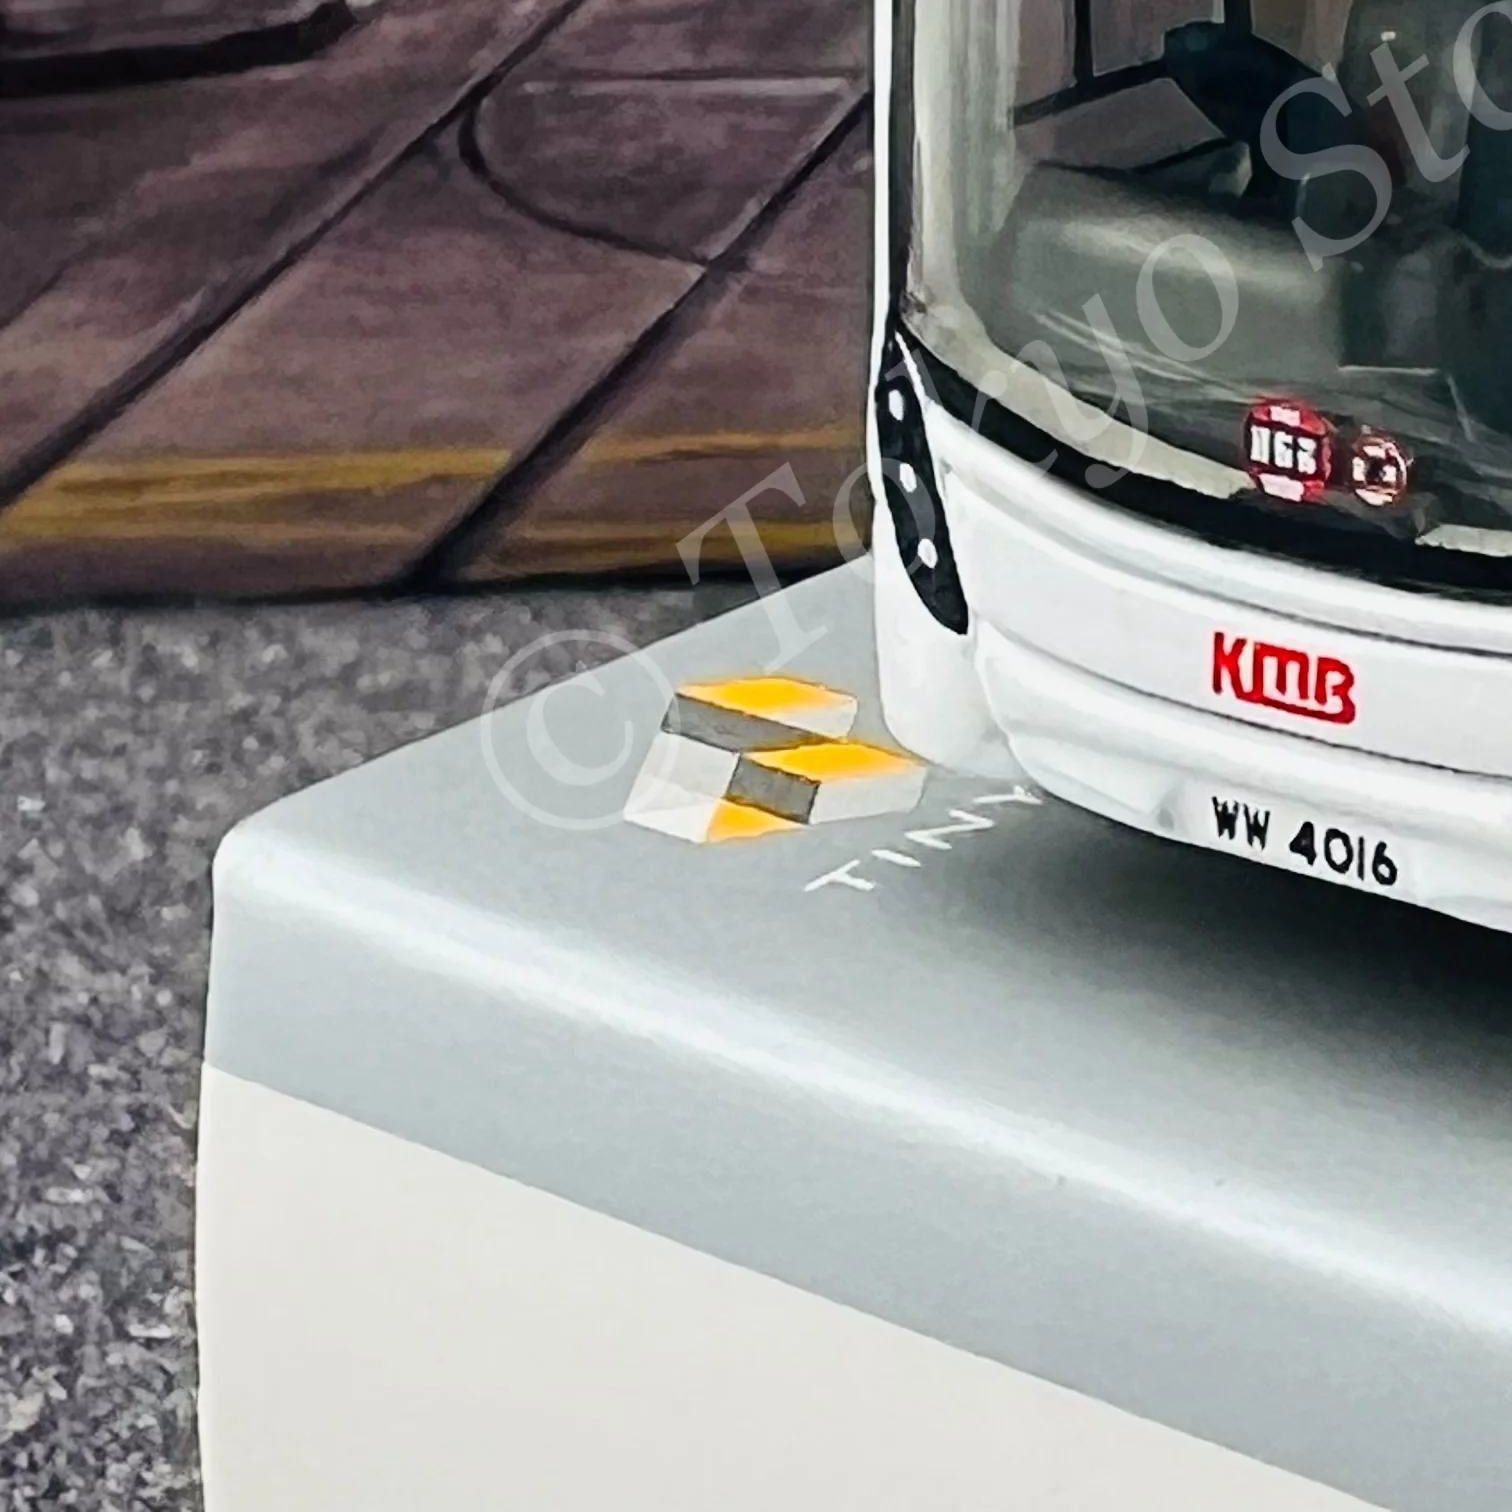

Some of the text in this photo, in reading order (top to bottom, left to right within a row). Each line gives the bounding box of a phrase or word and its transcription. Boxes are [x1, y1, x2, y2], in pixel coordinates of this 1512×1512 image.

[1211, 631, 1356, 725] KMB
[1211, 794, 1398, 887] WW 4016
